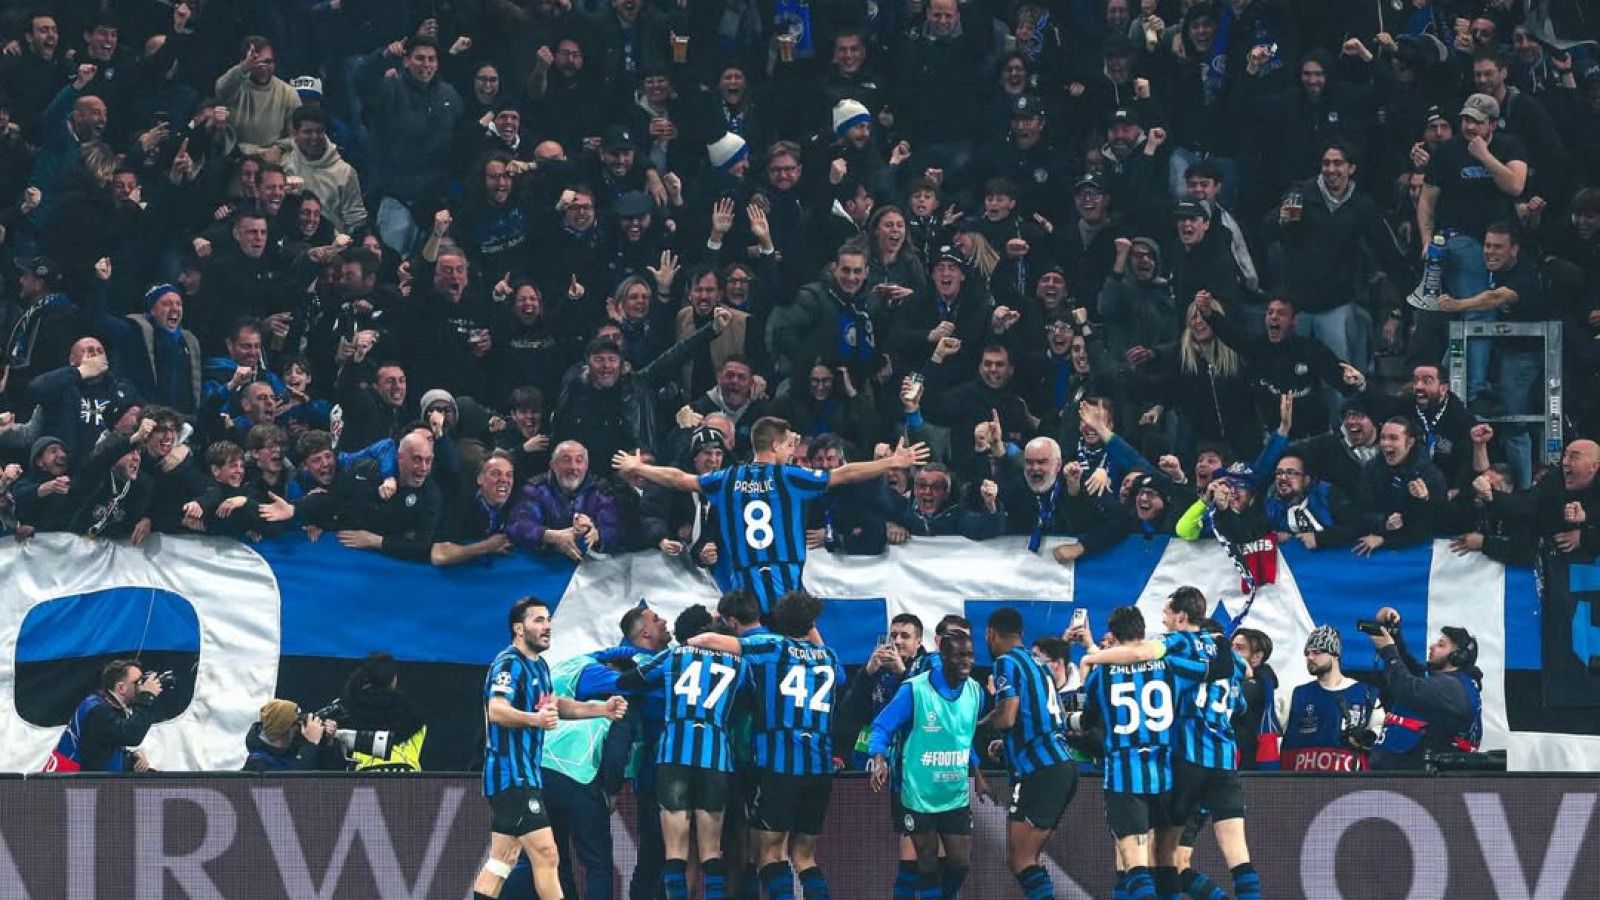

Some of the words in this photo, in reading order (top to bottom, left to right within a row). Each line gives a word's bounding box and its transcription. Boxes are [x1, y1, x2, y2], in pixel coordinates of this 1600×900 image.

[744, 500, 774, 549] 8
[673, 661, 736, 710] 47
[779, 665, 835, 713] 42
[1110, 680, 1174, 735] 59
